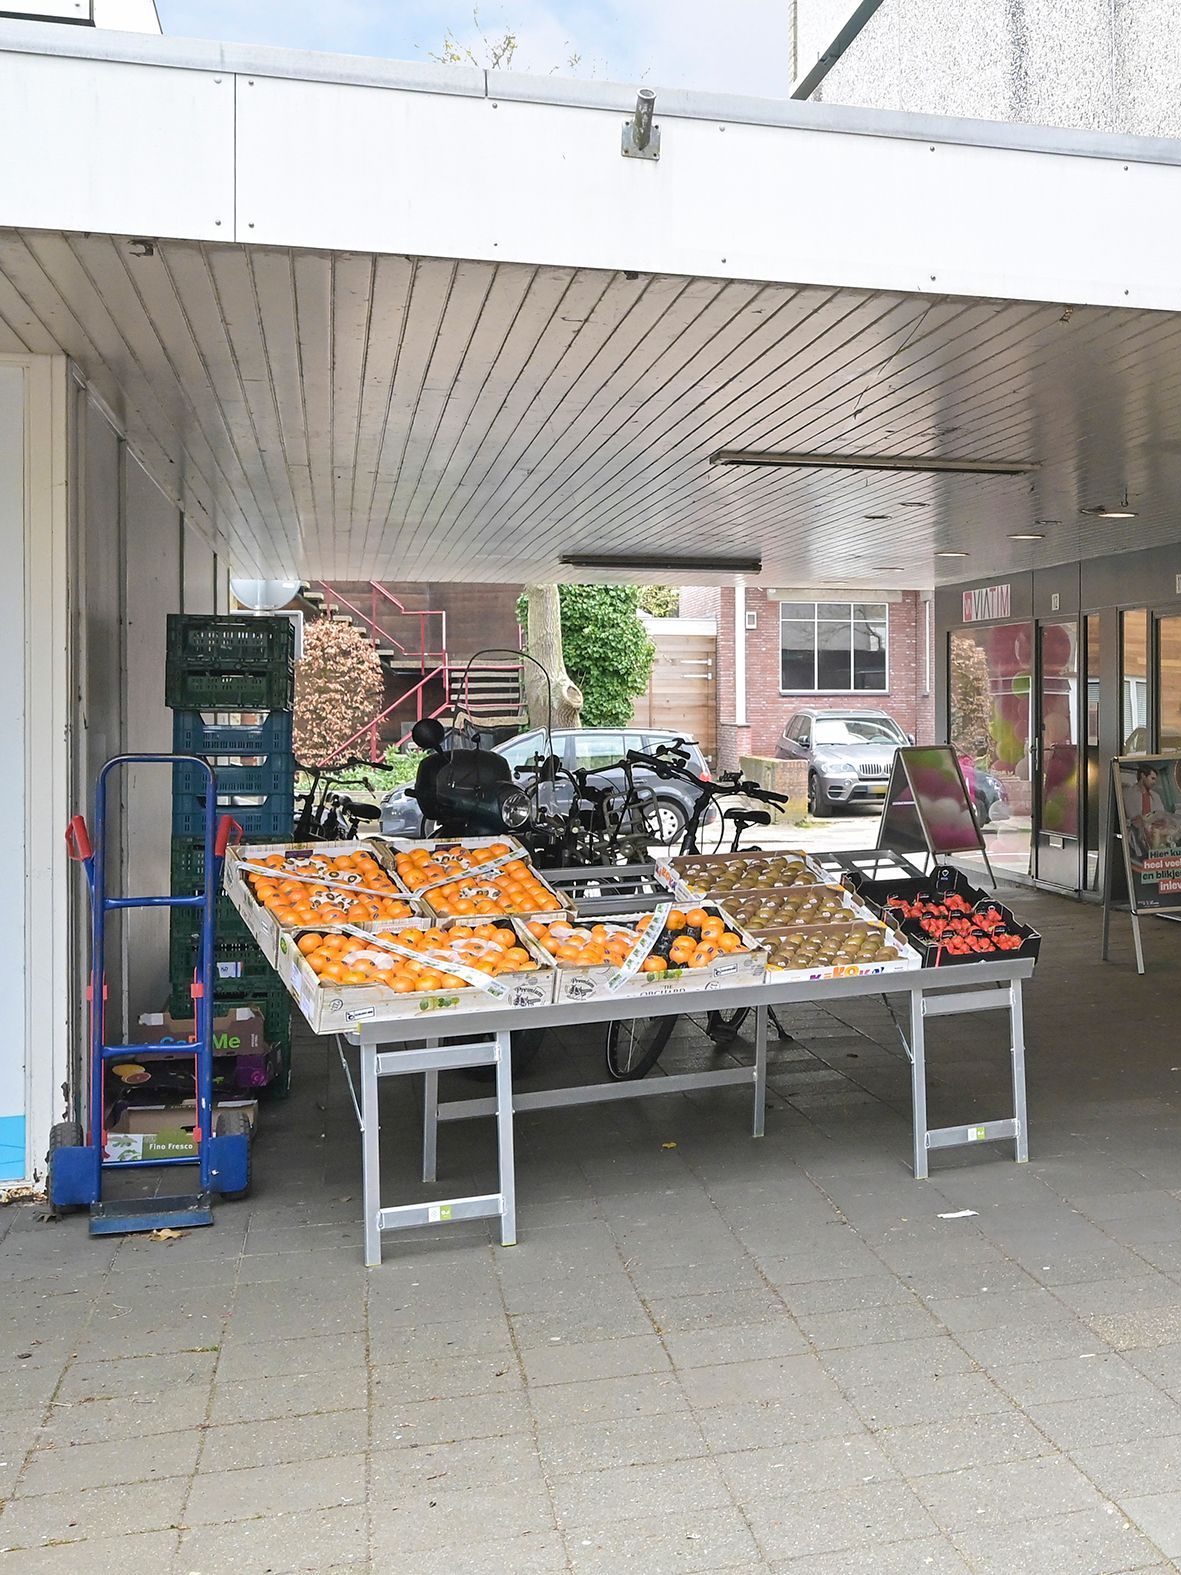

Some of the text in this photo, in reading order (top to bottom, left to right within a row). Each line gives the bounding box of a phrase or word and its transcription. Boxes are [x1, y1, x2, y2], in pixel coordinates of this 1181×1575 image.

[1150, 851, 1169, 859] Hier
[1144, 861, 1163, 870] heel
[515, 986, 544, 998] Premium
